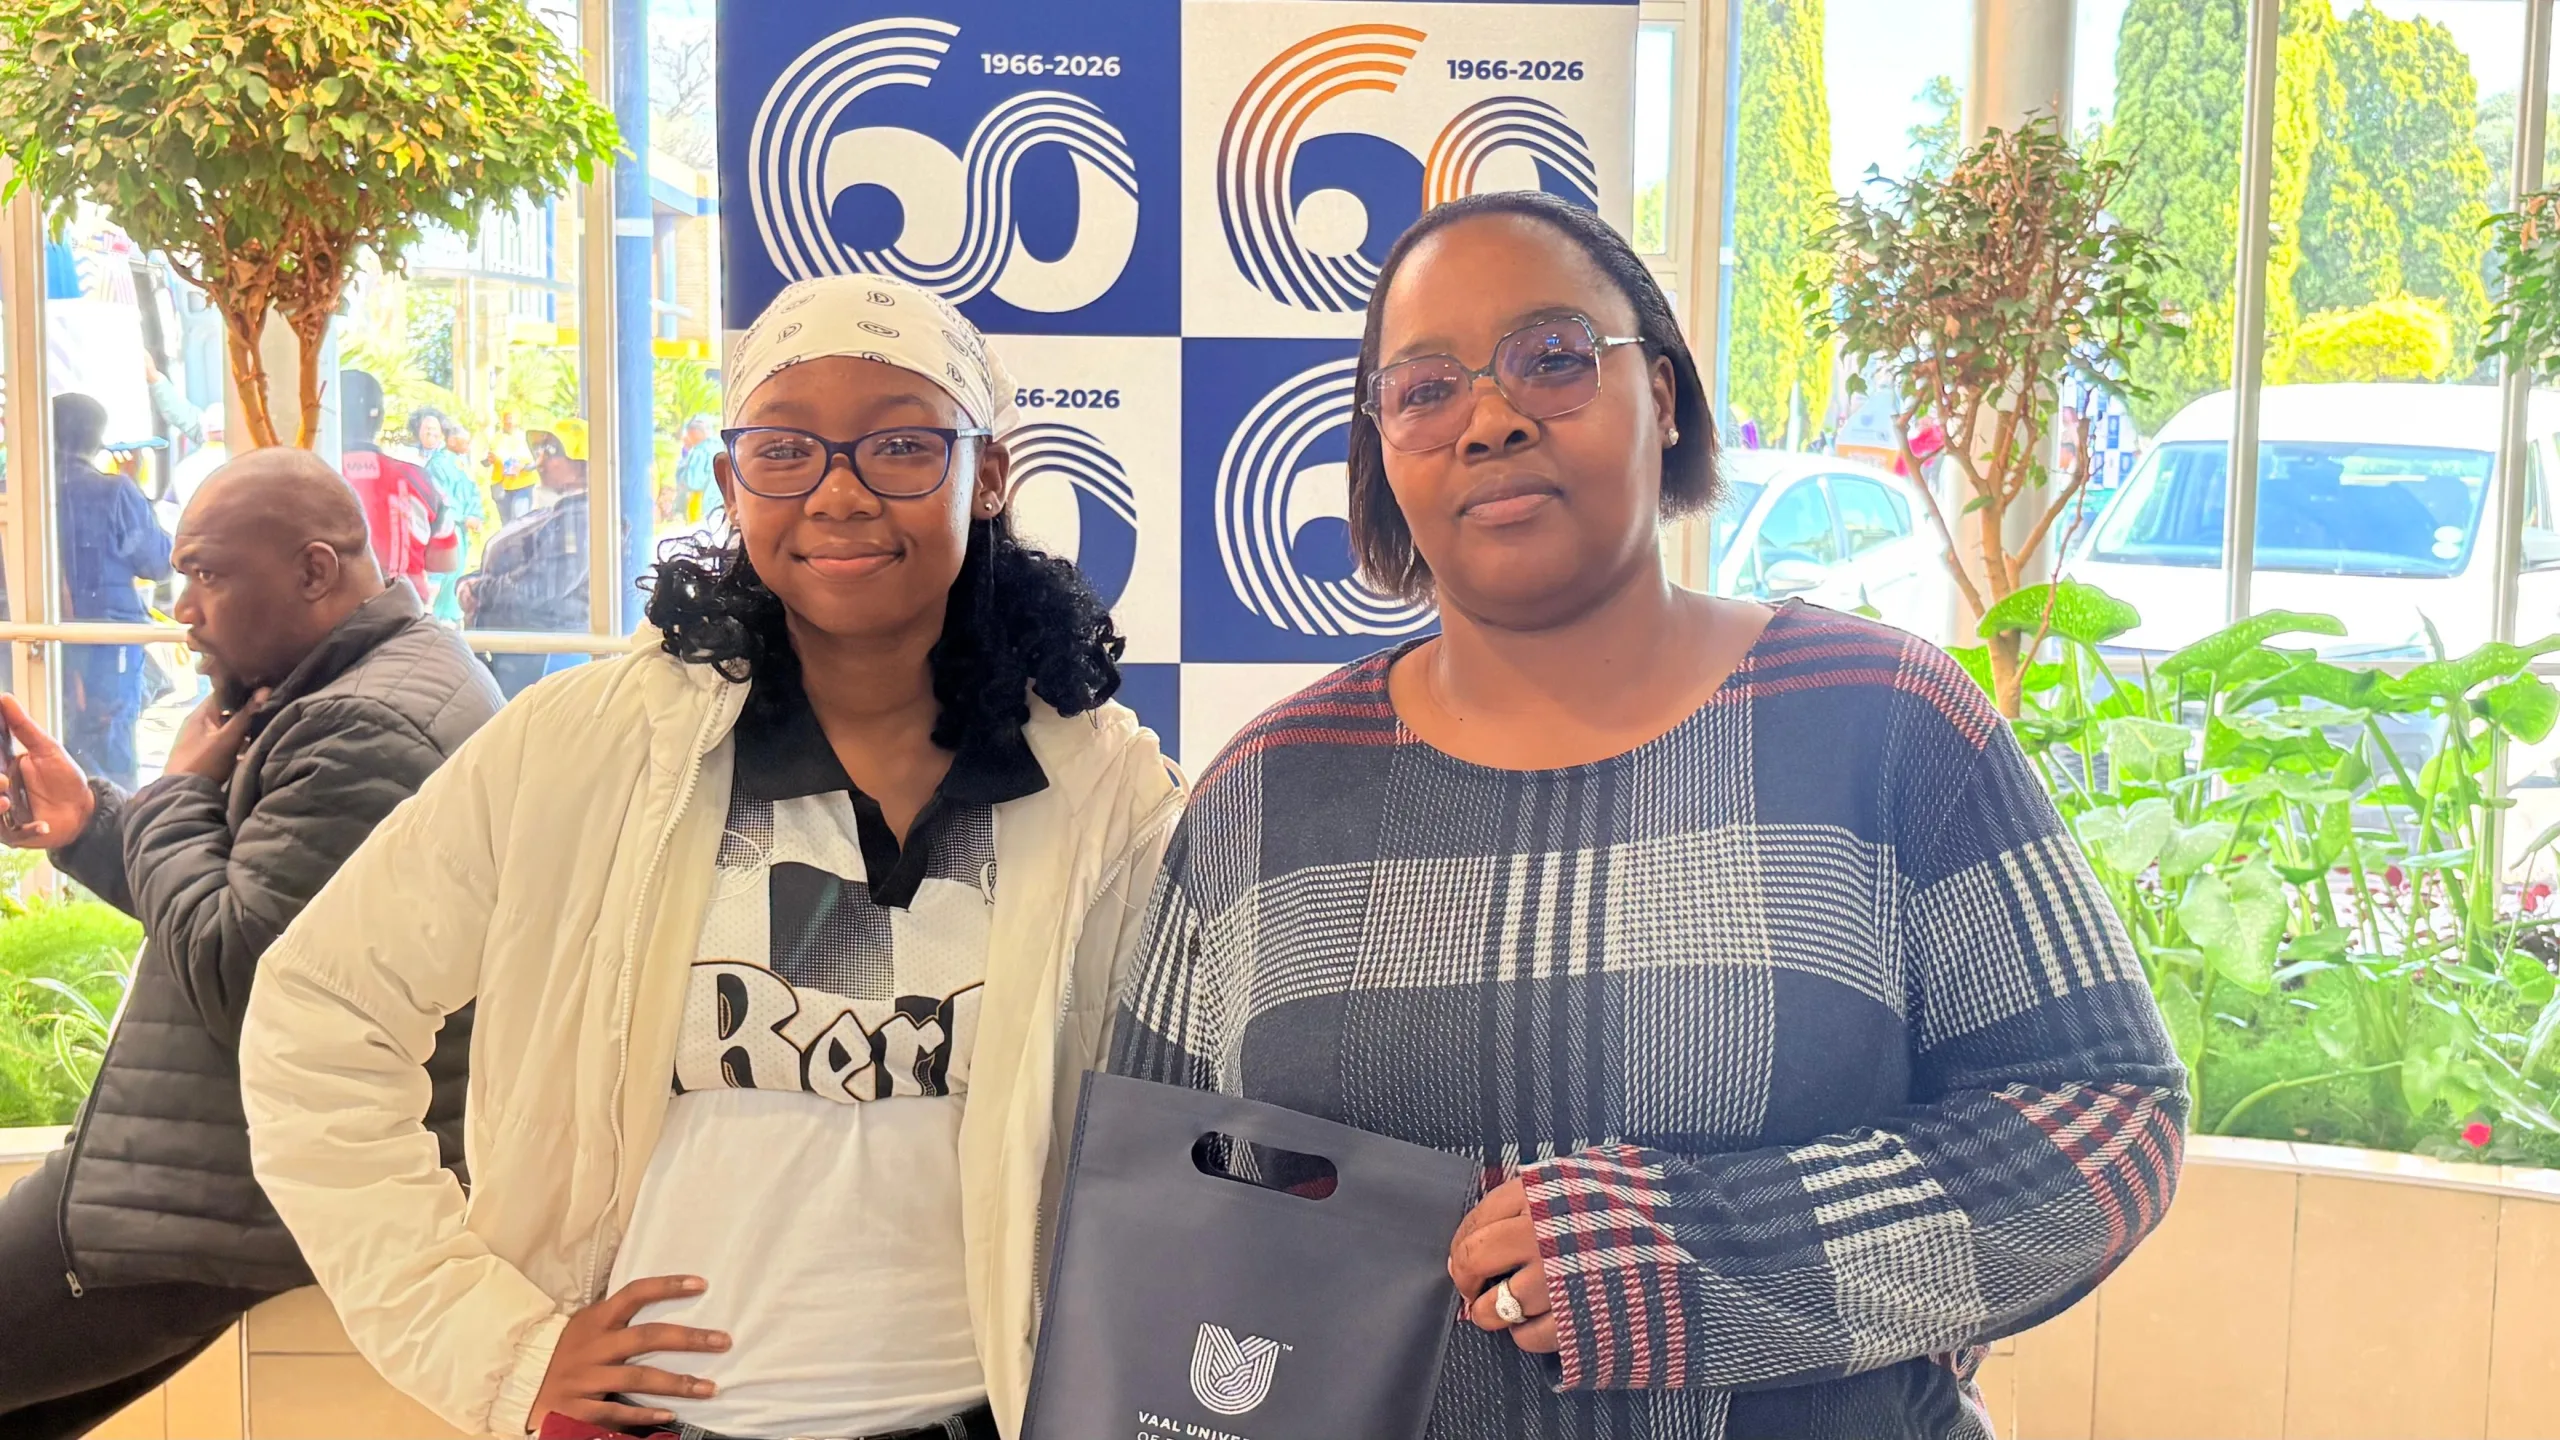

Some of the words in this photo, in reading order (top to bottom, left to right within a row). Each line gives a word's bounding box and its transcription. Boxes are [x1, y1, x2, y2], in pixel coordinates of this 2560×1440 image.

[980, 53, 1122, 77] 1966-2026
[1446, 59, 1585, 81] 1966-2026
[748, 17, 1139, 313] 60
[1014, 388, 1121, 409] 66-2026
[676, 957, 986, 1105] Rer
[1138, 1410, 1182, 1432] VAAL
[1186, 1423, 1251, 1440] UNIV
